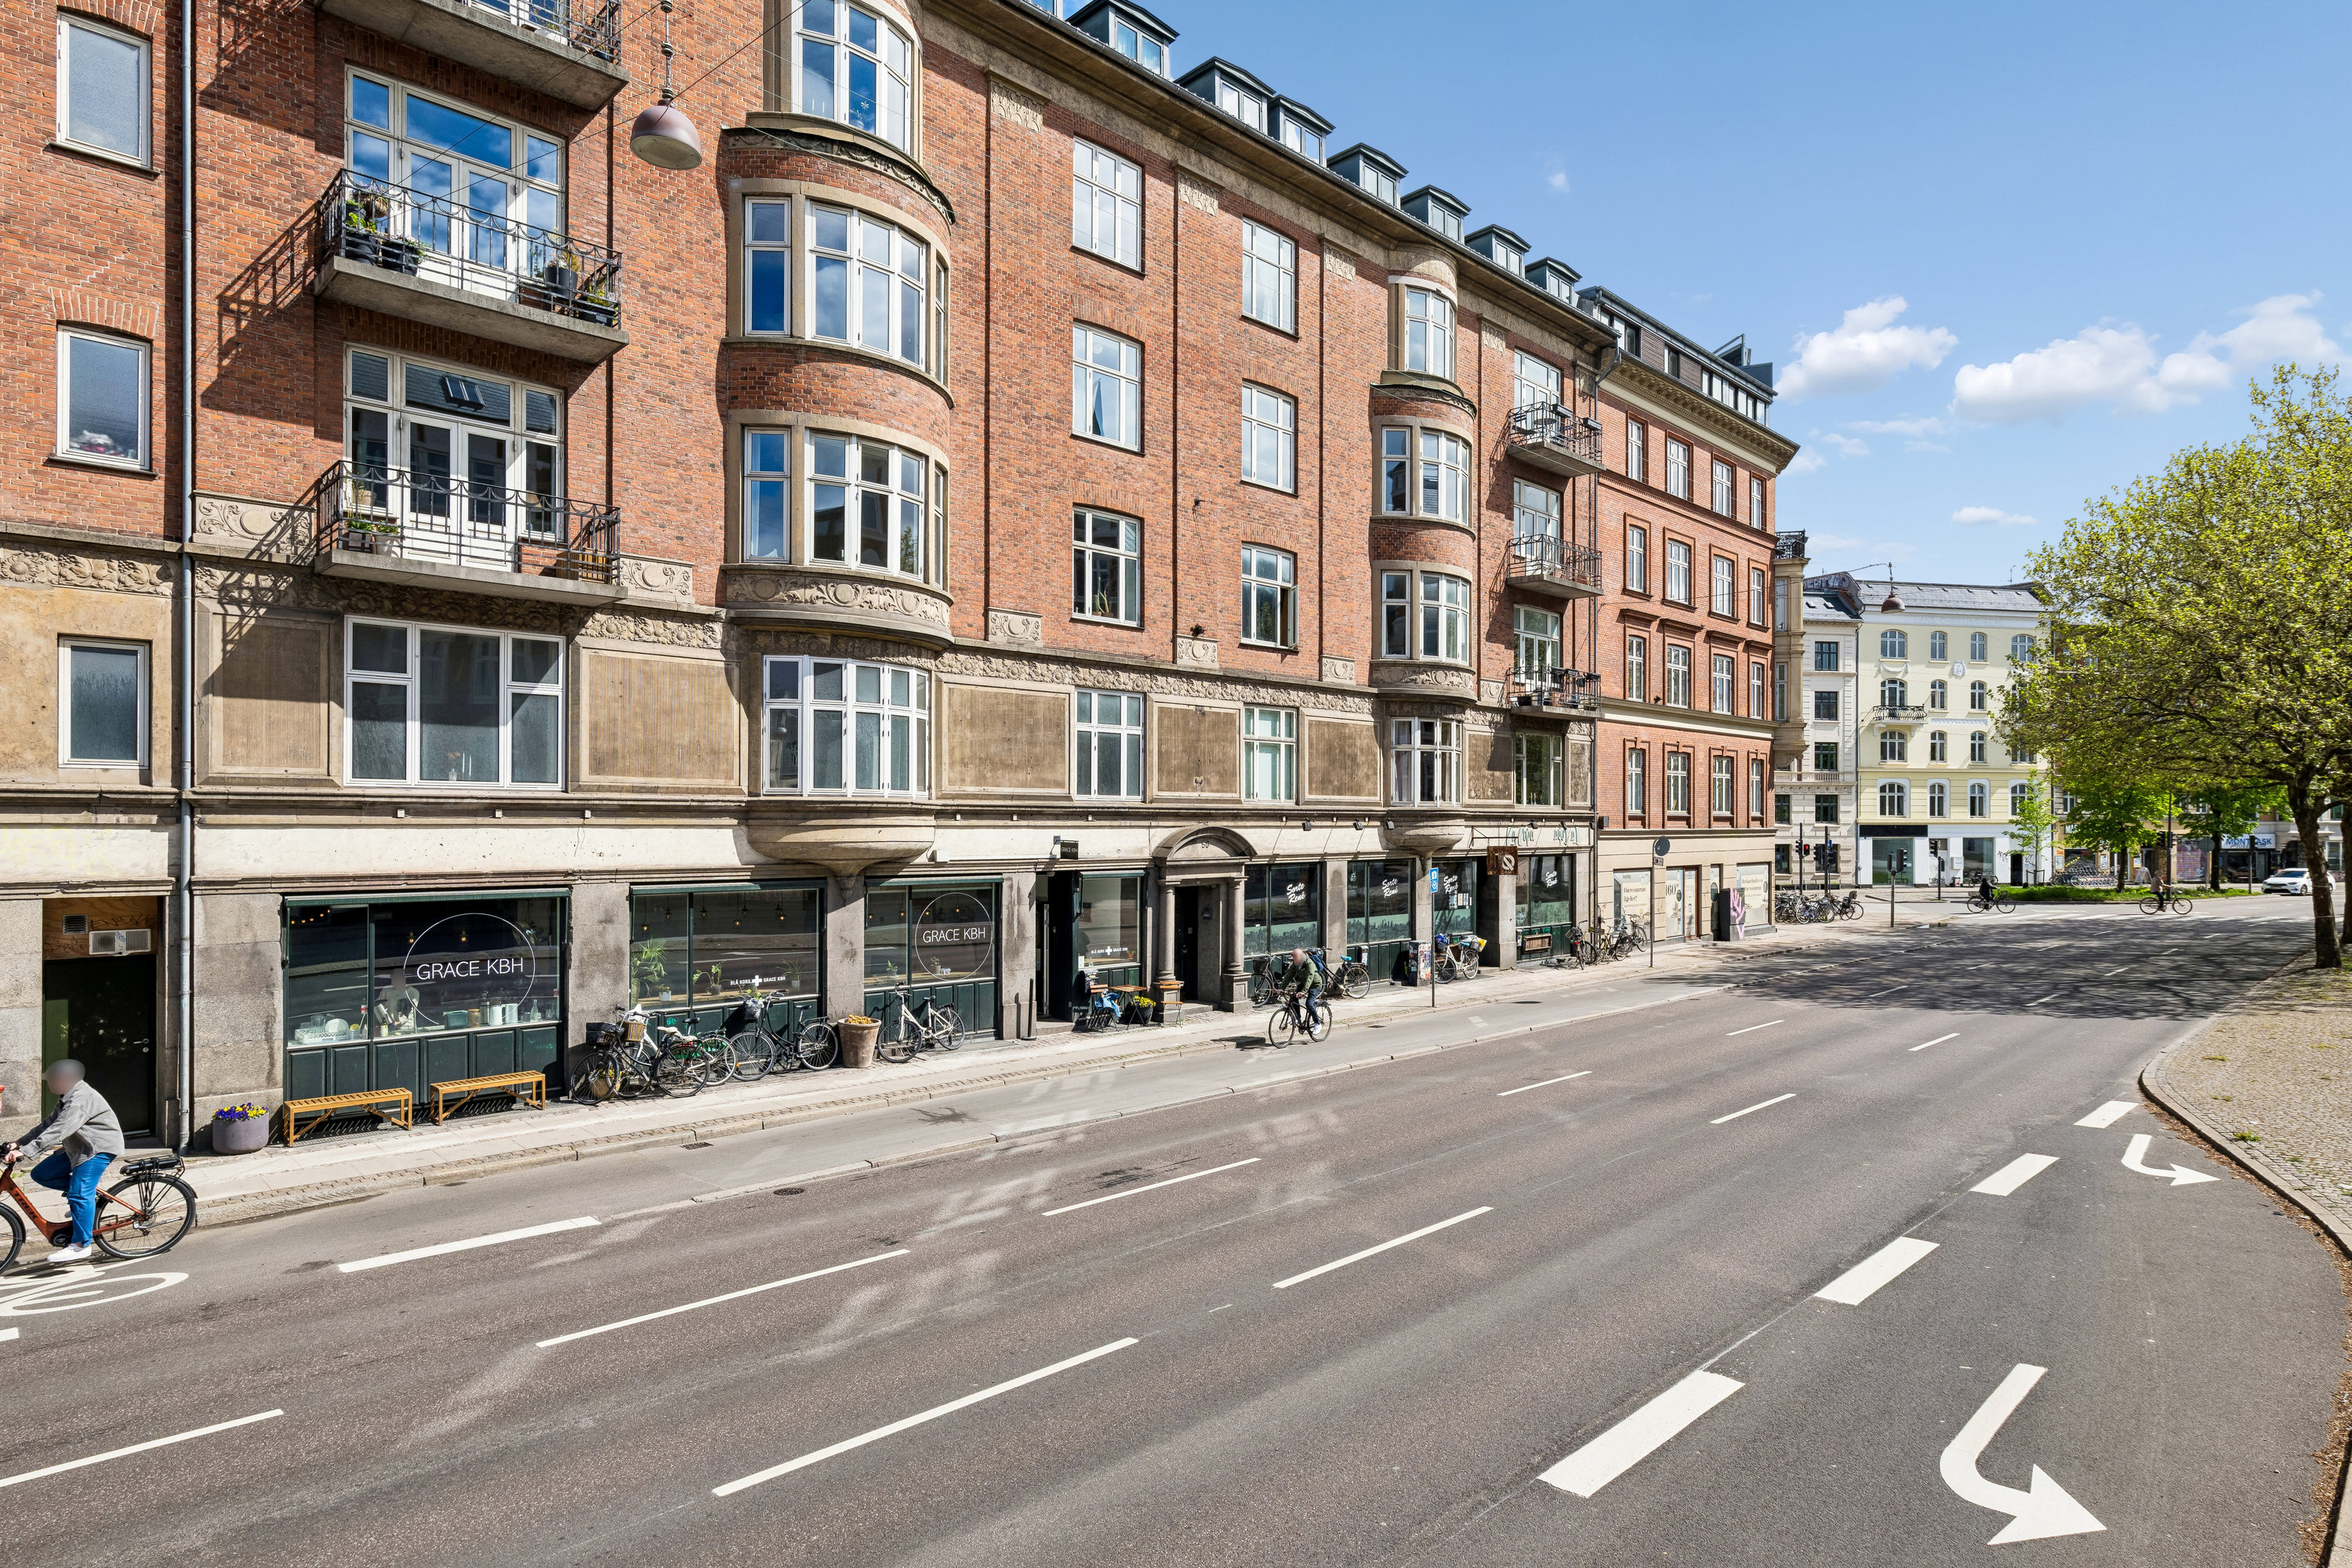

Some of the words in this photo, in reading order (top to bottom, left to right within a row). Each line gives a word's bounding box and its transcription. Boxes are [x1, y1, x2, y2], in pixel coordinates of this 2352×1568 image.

[1443, 874, 1458, 886] Sorte
[1545, 870, 1557, 880] Sorte
[1287, 882, 1305, 895] Sorte
[1381, 878, 1398, 890] Sorte
[1444, 882, 1458, 894] René
[1288, 891, 1306, 905] René
[1383, 886, 1399, 898] René
[922, 928, 960, 943] GRACE
[964, 927, 985, 940] KBH
[416, 960, 480, 980] GRACE
[487, 957, 524, 975] KBH
